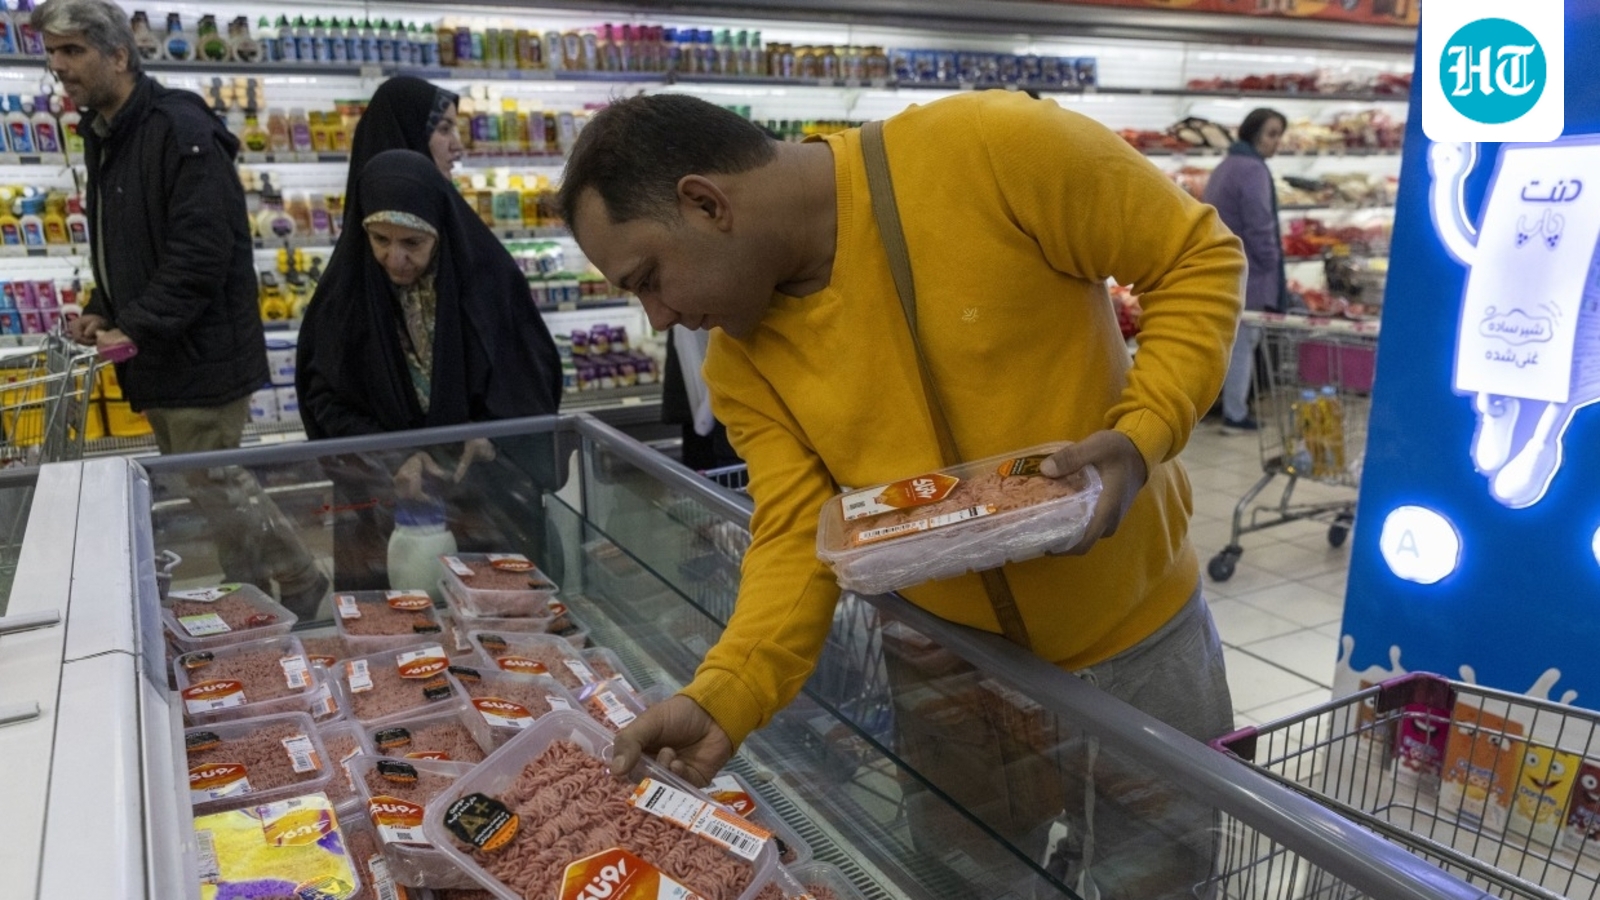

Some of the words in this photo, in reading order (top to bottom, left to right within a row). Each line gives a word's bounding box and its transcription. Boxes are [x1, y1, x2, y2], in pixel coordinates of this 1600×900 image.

[1521, 179, 1583, 203] دنت
[1488, 321, 1519, 334] ساده
[1519, 322, 1544, 338] شیر
[1396, 529, 1420, 558] A
[459, 801, 490, 839] A+
